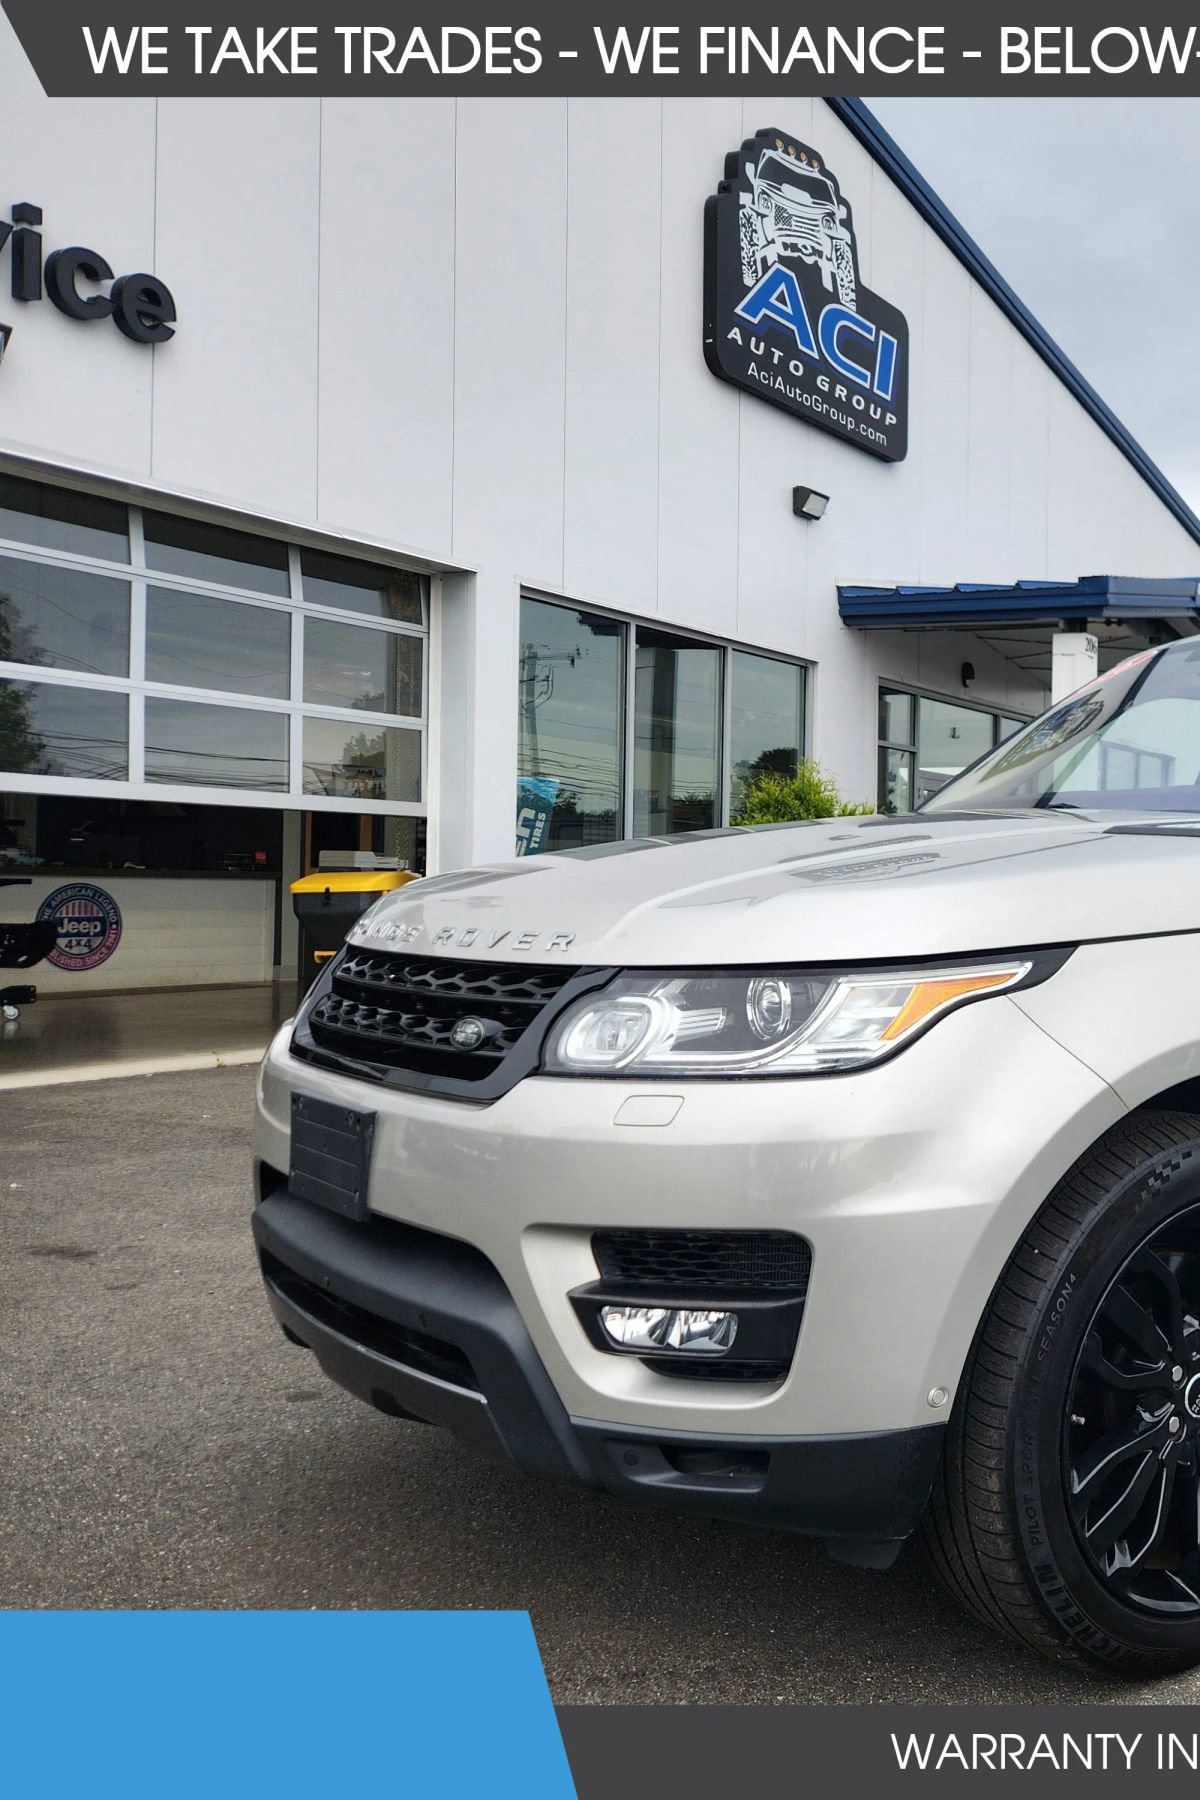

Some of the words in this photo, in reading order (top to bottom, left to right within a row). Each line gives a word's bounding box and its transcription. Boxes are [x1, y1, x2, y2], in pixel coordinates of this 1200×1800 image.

[734, 262, 898, 401] ACI
[727, 326, 804, 377] AUTO
[816, 377, 897, 426] GROUP
[747, 361, 888, 447] AciAutoGroup.com
[529, 812, 546, 848] TIRES
[50, 887, 95, 908] AMERICAN
[95, 892, 117, 922] LEGEND
[57, 918, 102, 936] Jeep
[432, 926, 577, 951] ROVER
[1024, 1494, 1043, 1546] PILOT
